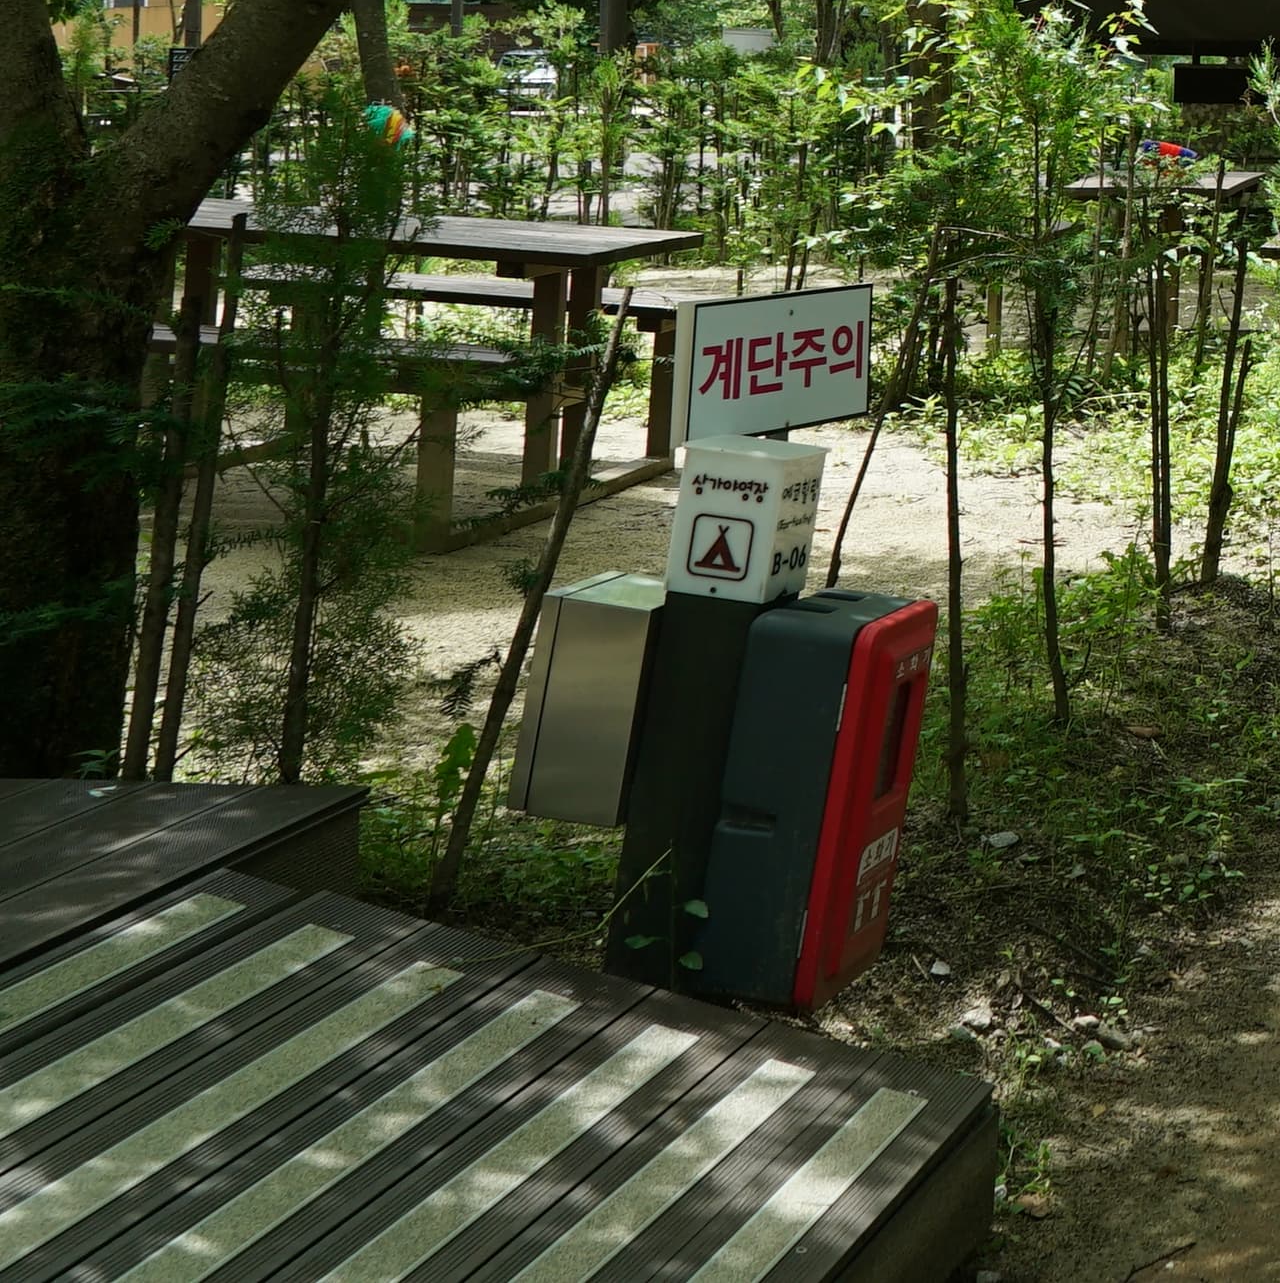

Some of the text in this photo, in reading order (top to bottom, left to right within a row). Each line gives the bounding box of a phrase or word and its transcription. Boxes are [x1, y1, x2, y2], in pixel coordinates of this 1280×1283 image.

[699, 321, 864, 400] 계단주의
[691, 473, 769, 503] 삼가야영장
[771, 544, 806, 576] B-06
